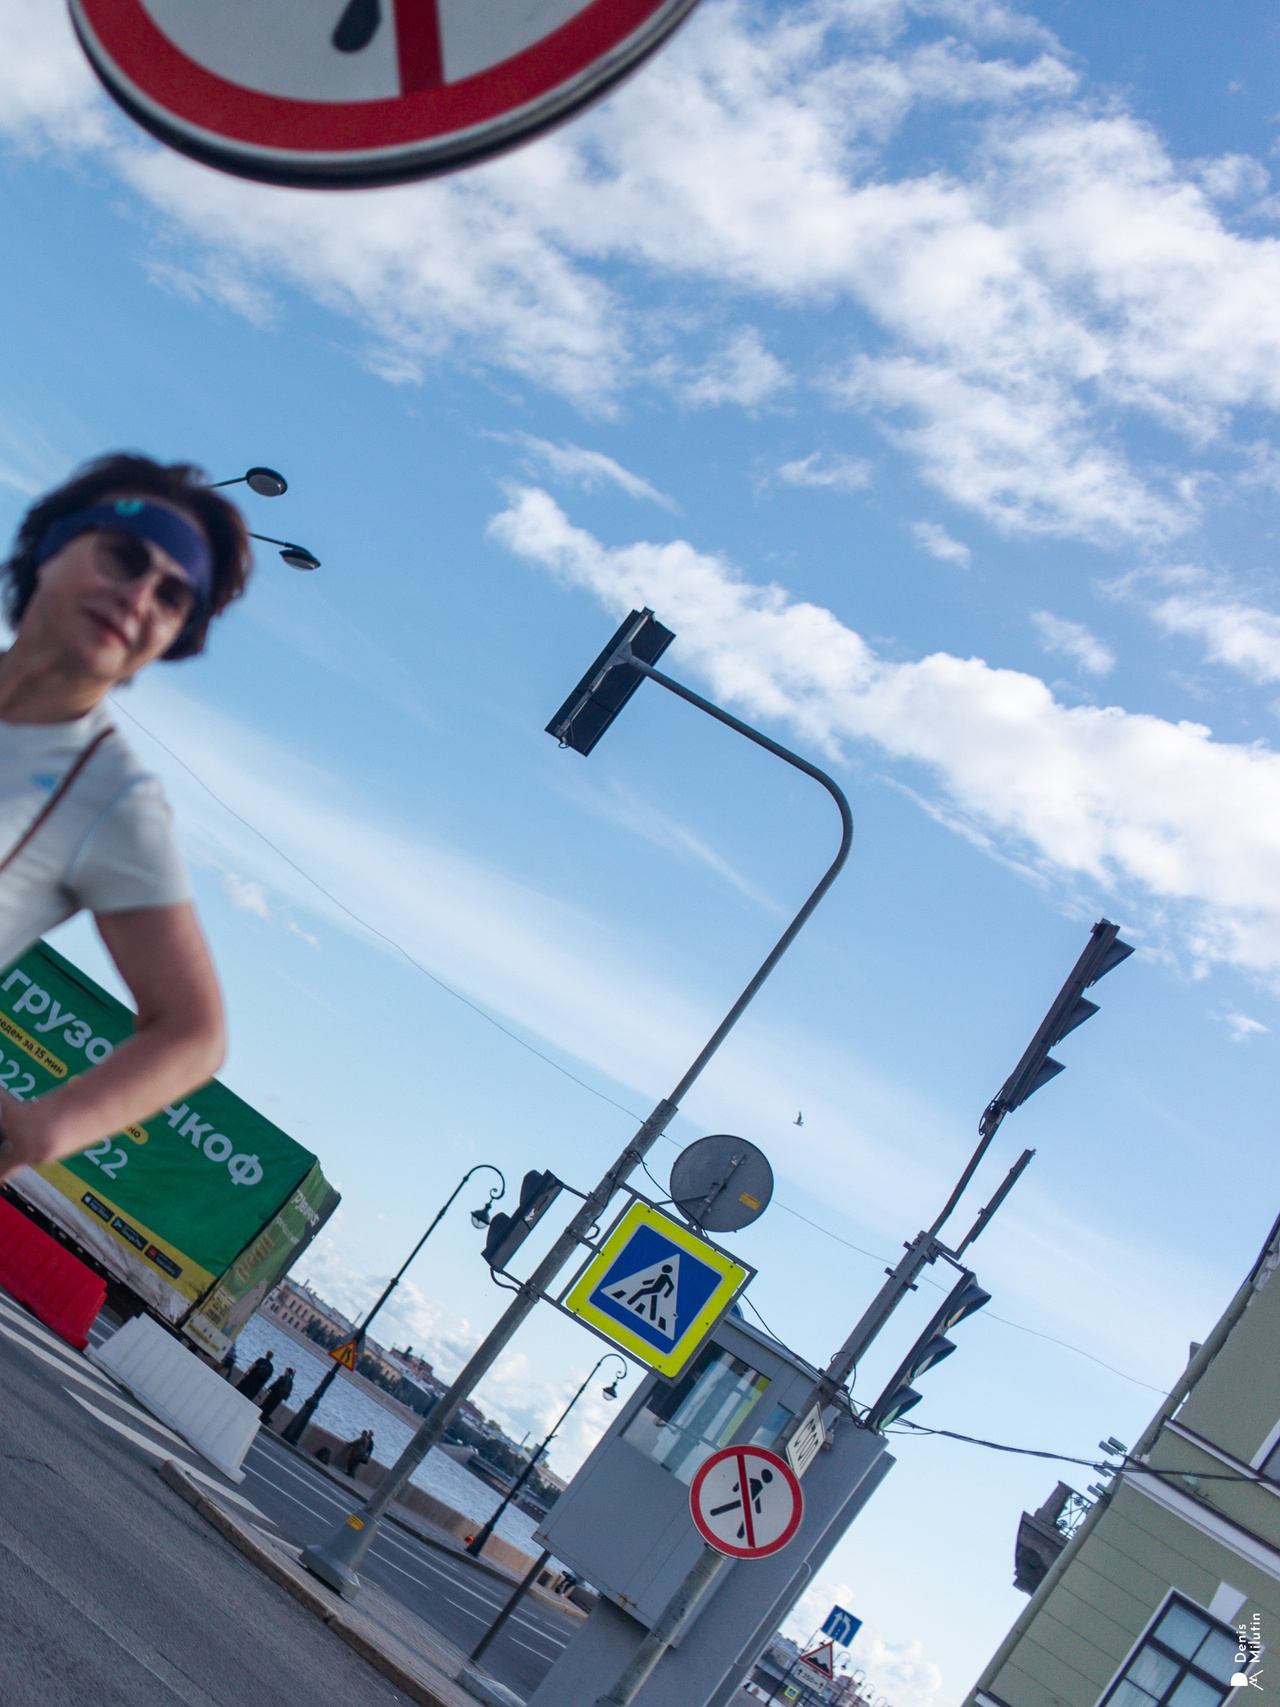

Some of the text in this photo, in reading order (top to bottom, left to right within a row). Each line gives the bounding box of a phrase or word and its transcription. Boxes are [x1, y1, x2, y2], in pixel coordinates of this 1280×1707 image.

[22, 1038, 34, 1051] за
[34, 1047, 46, 1059] 15
[44, 1057, 64, 1075] мин
[794, 1418, 819, 1470] СТОП
